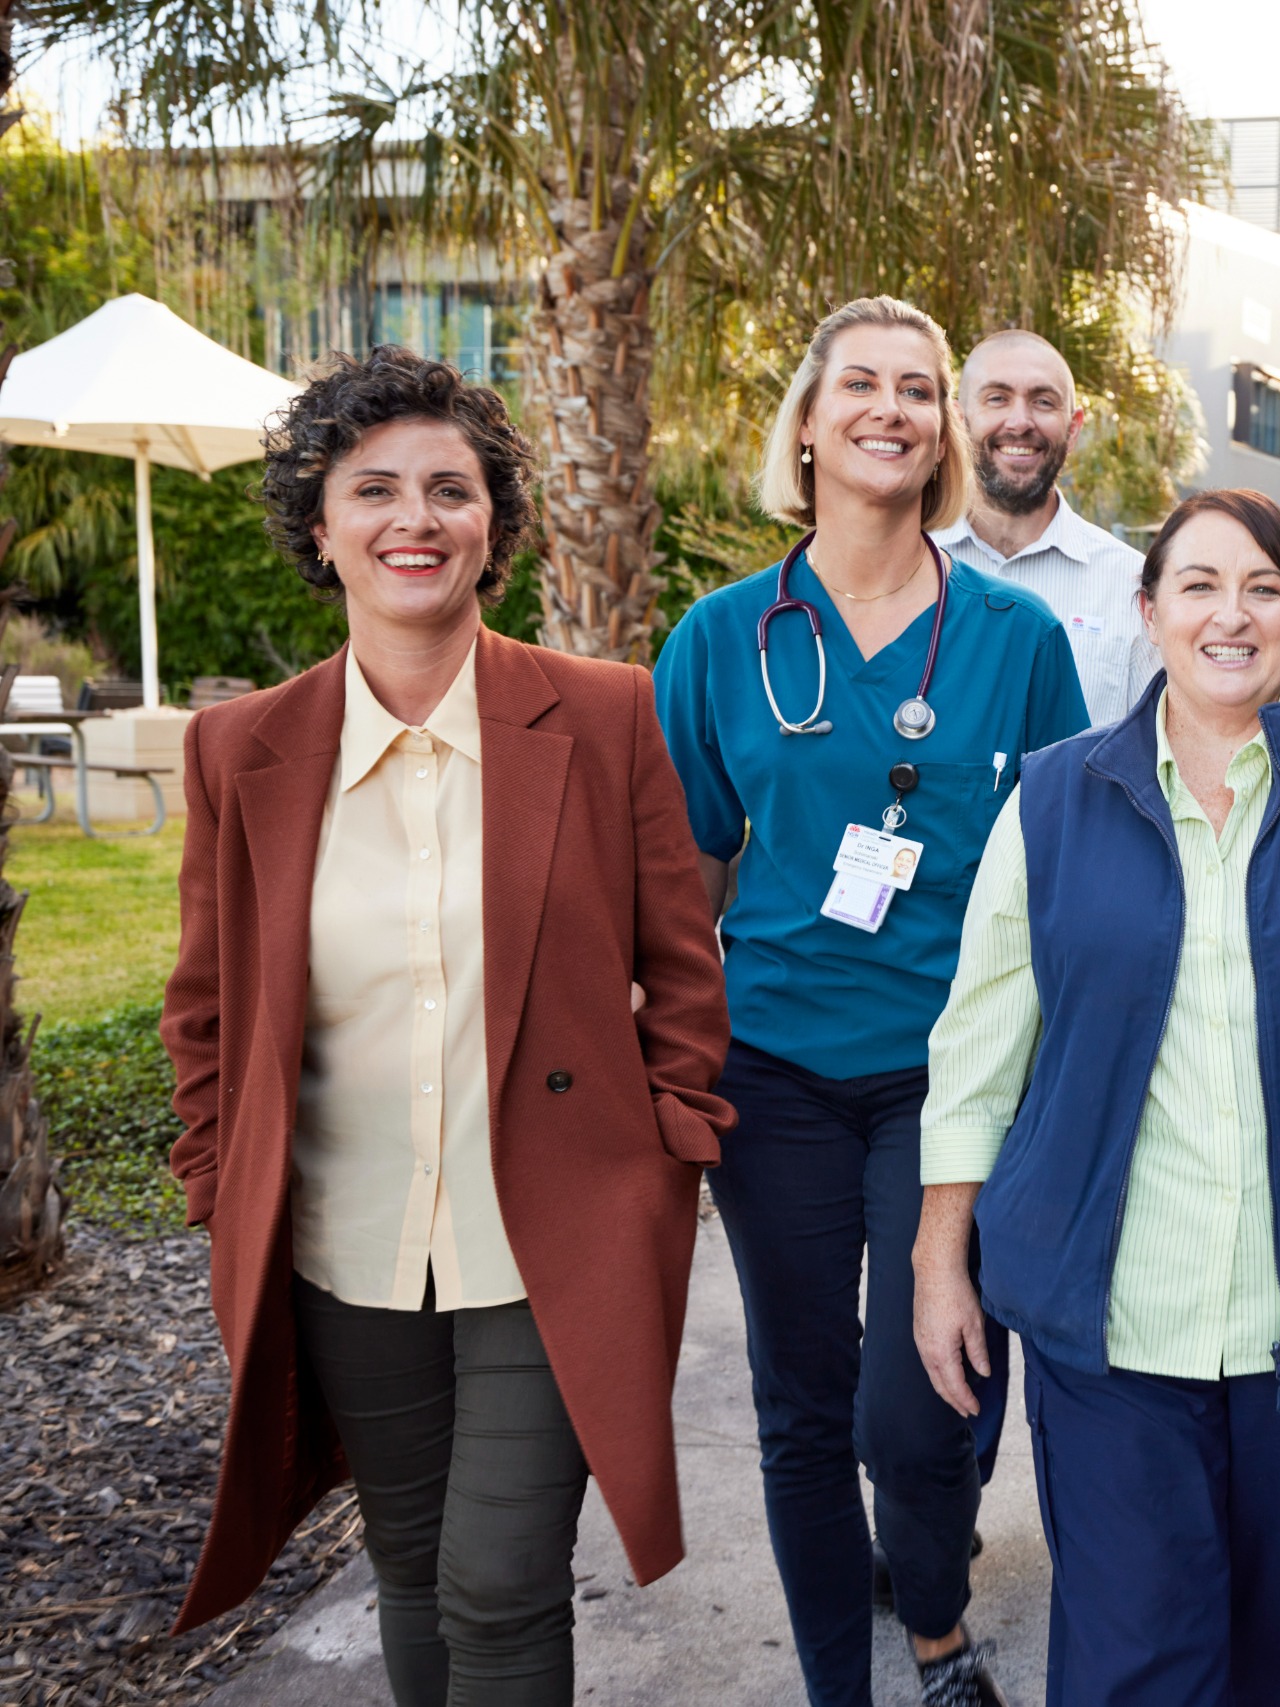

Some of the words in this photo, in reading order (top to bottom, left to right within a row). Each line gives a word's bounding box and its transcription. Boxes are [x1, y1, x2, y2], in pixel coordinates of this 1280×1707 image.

[865, 845, 879, 853] INGA
[839, 853, 854, 861] SENIOR
[854, 857, 871, 866] MEDICAL
[871, 862, 889, 870] OFFICER
